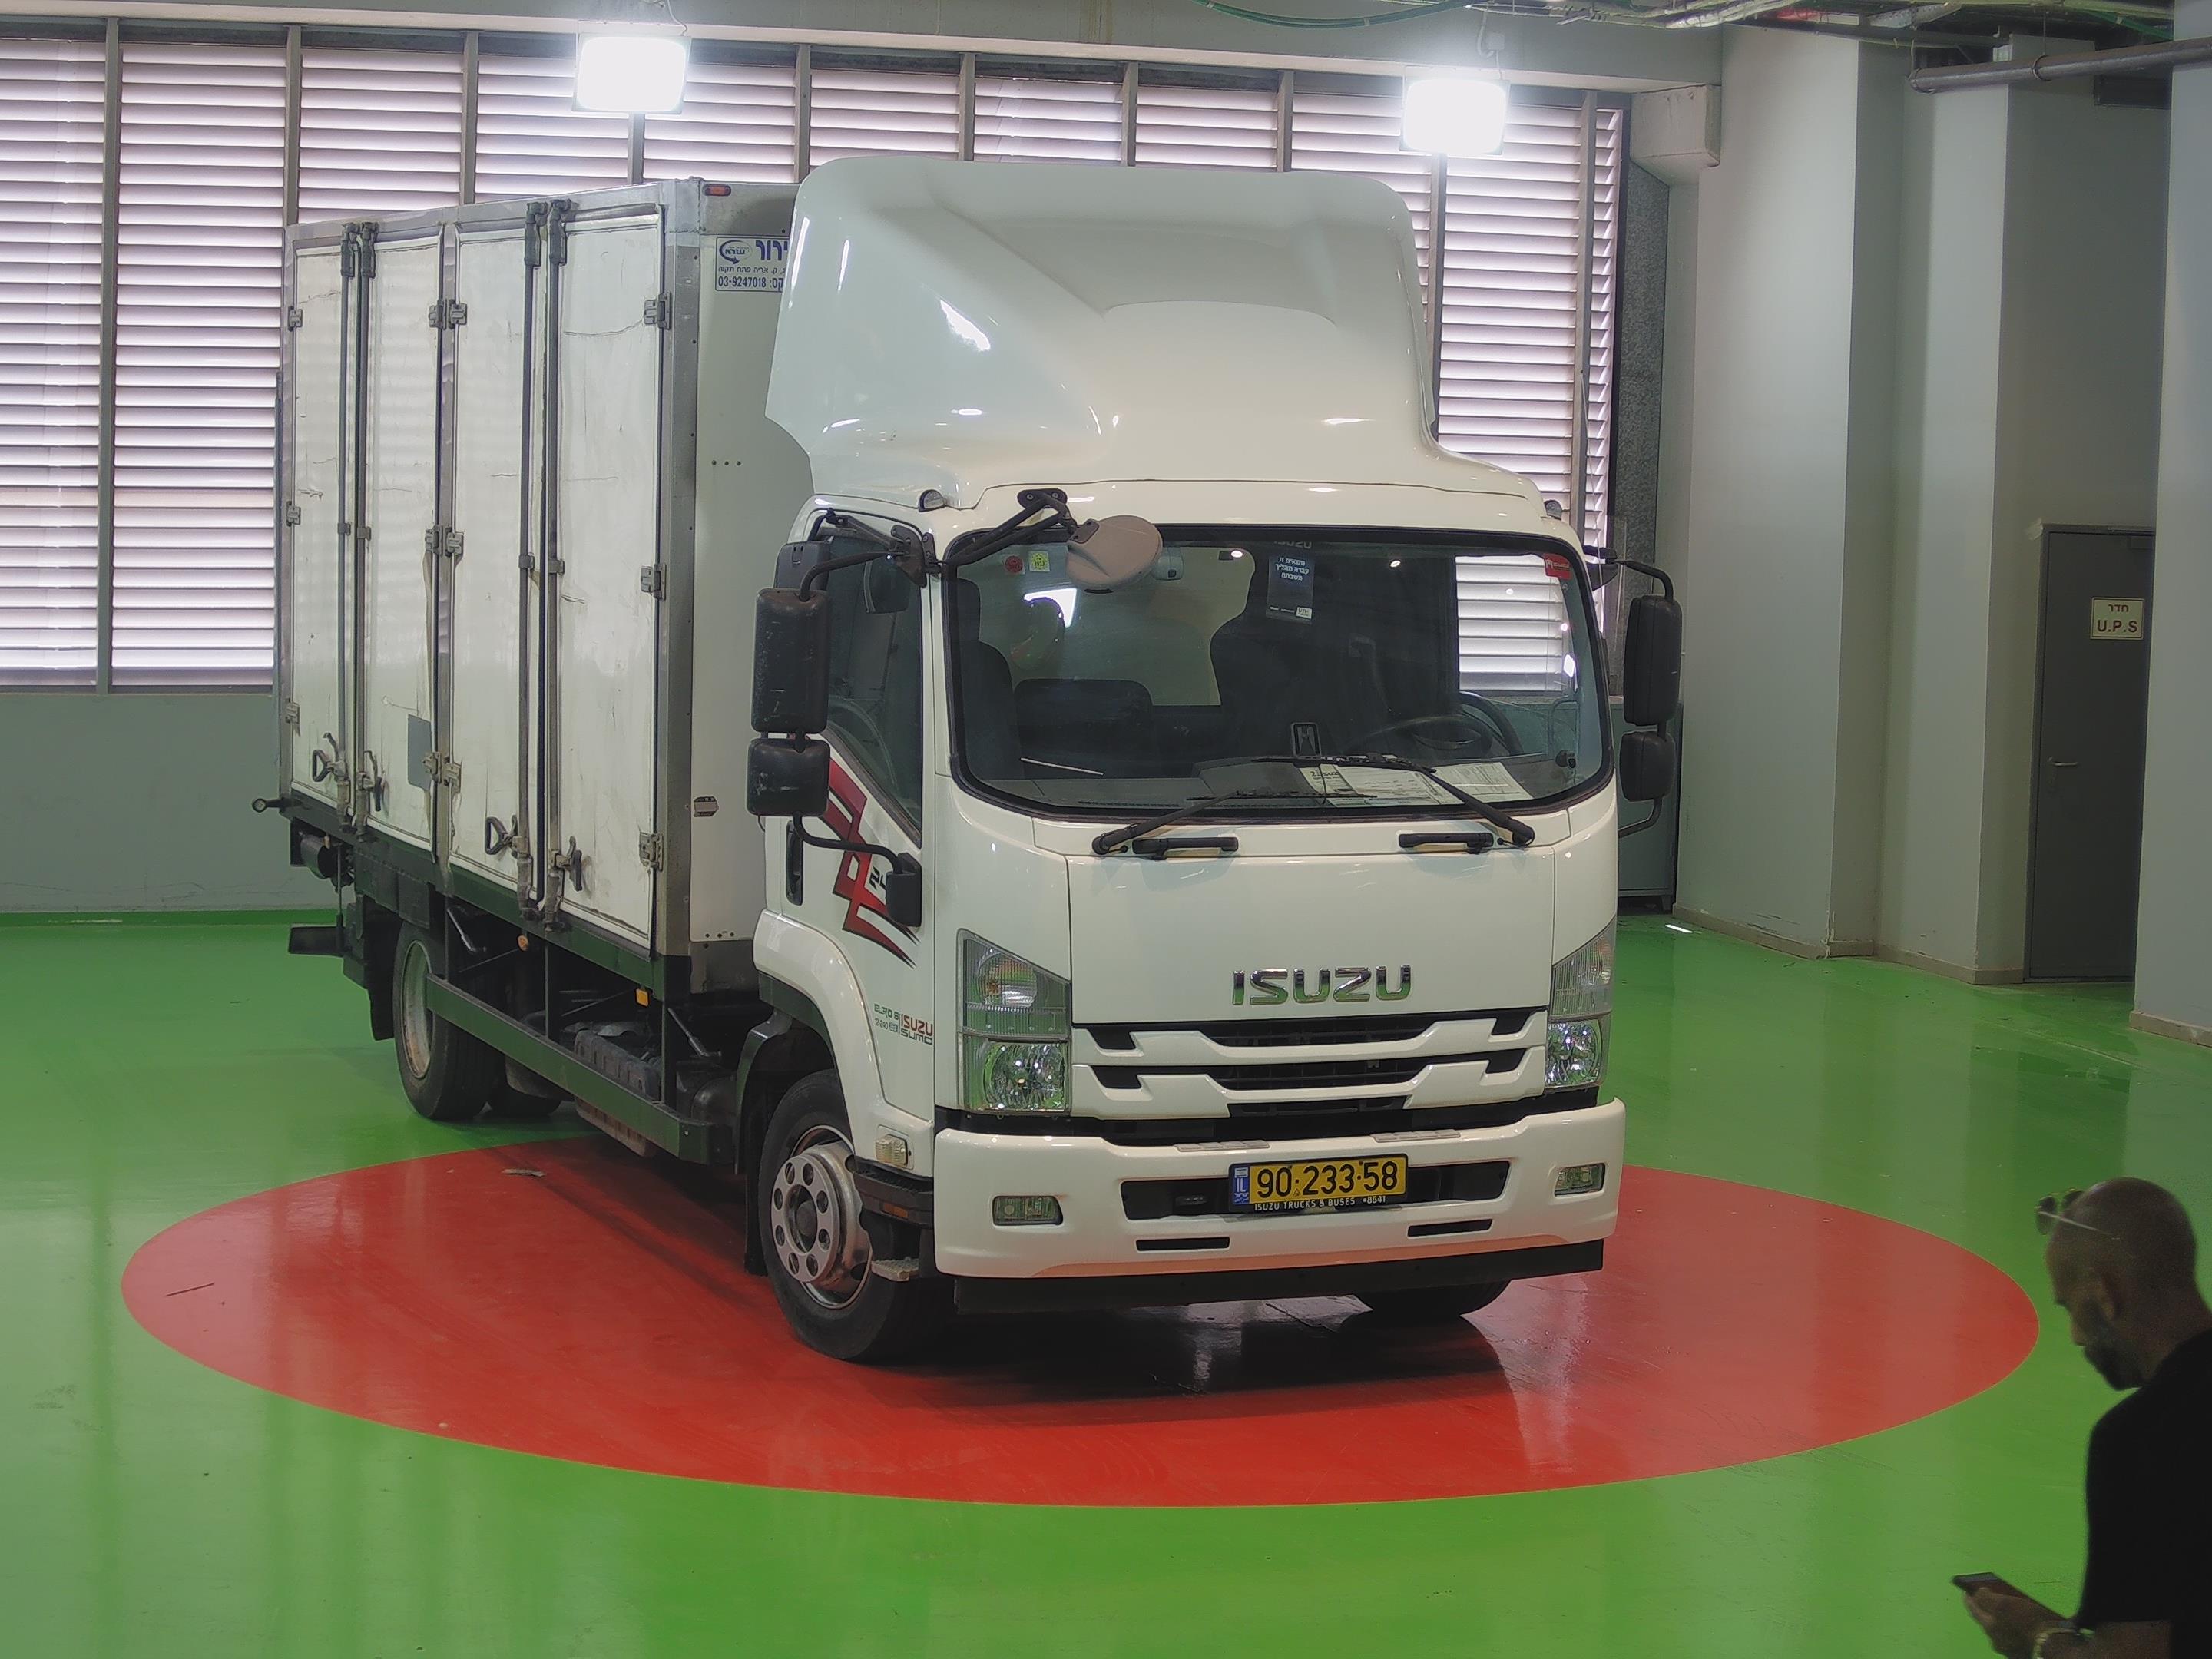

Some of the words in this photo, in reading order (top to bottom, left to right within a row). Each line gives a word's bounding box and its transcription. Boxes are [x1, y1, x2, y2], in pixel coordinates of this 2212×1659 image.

[756, 240, 788, 261] ירור
[718, 276, 767, 288] 03-9247018
[770, 277, 783, 291] קס:
[2108, 604, 2129, 612] חדר
[2097, 620, 2138, 632] U.P.S
[1232, 965, 1412, 1005] ISUZU
[901, 1014, 933, 1036] ISUZU
[901, 1028, 933, 1045] SUMO
[1236, 1177, 1247, 1193] IL
[1254, 1200, 1280, 1212] ISUZU
[1283, 1199, 1316, 1210] TRUCKS
[1328, 1197, 1356, 1207] BUSES
